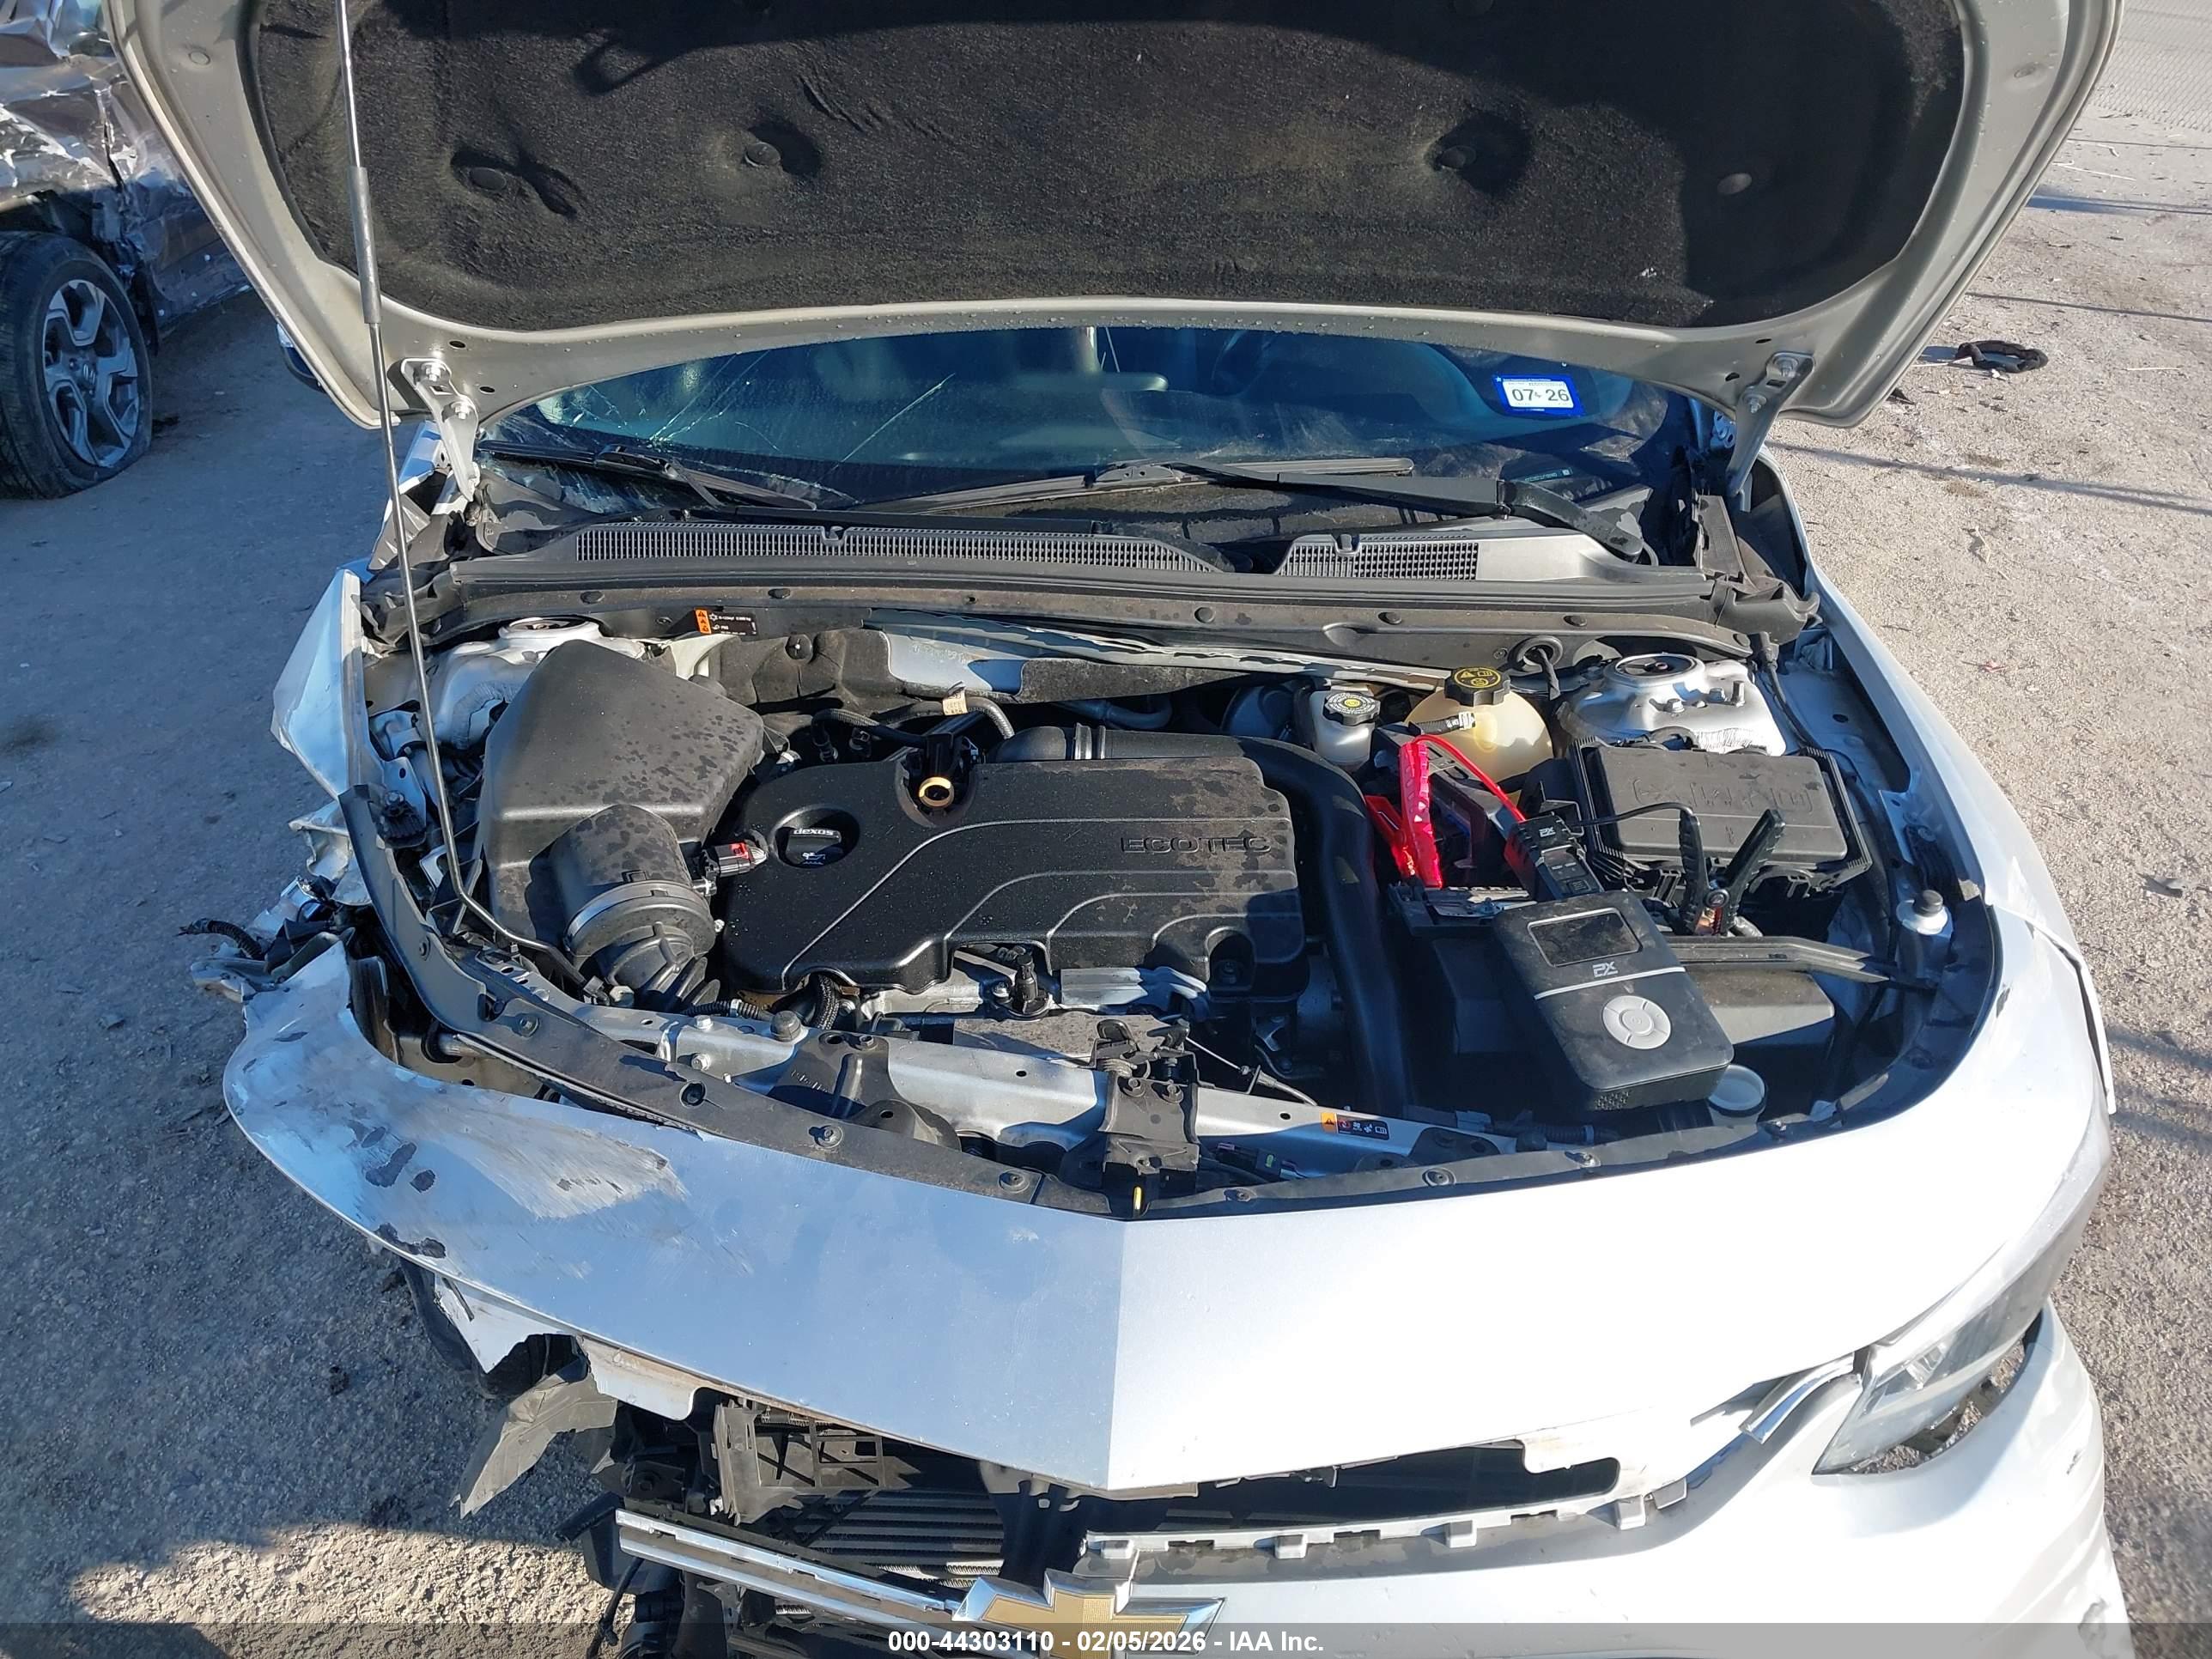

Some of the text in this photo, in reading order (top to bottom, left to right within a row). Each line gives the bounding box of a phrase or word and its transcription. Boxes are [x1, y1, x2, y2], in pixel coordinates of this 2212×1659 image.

[1511, 388, 1570, 402] 07 26
[1120, 836, 1272, 854] ECOTEC
